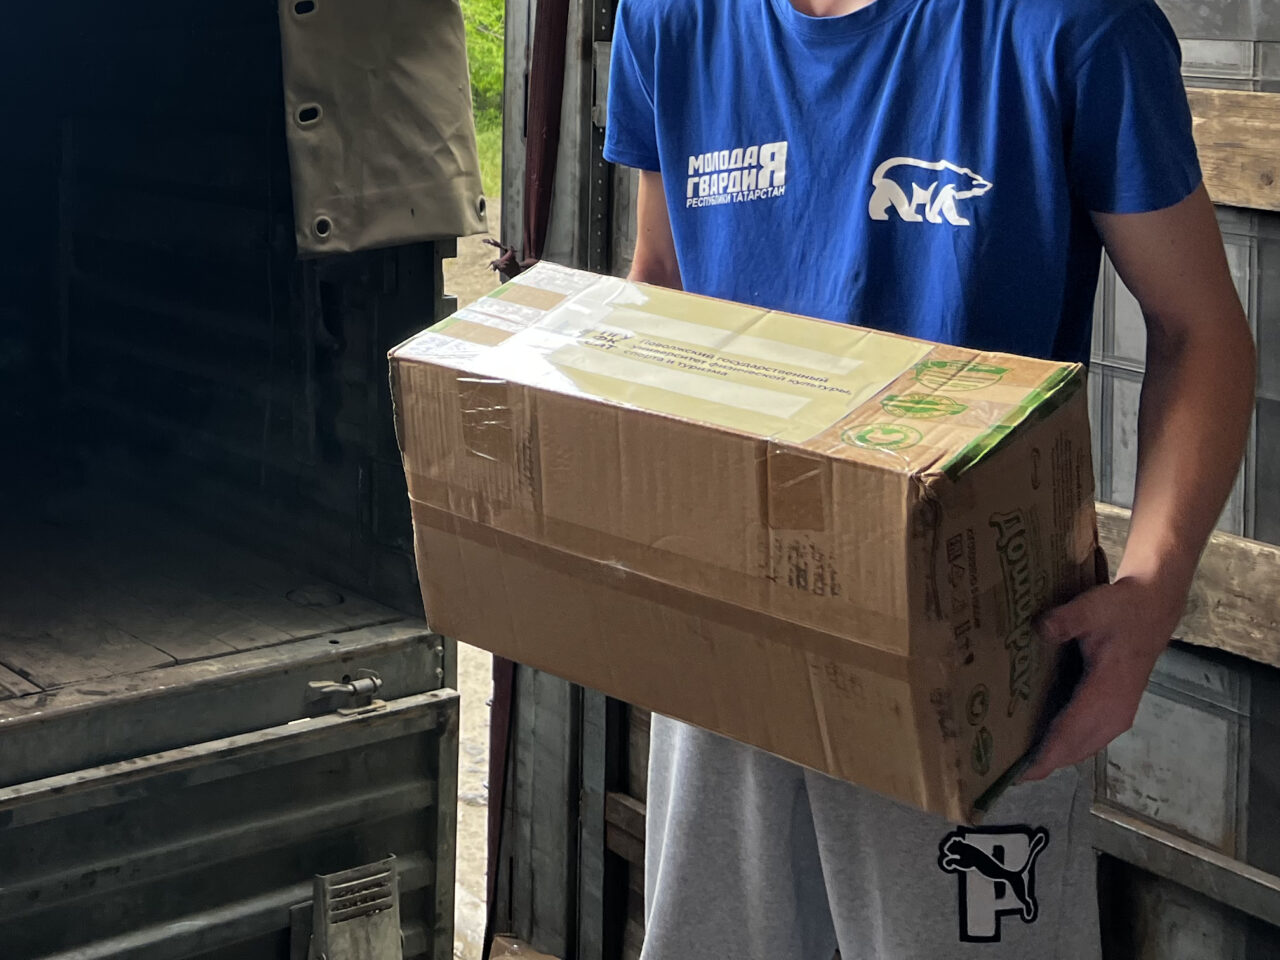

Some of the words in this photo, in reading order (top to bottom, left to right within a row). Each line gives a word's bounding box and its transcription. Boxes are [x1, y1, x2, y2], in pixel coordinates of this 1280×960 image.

[732, 185, 786, 203] ТАТАРСТАН
[624, 349, 664, 363] спорта
[677, 362, 728, 377] туризма
[632, 344, 706, 365] университет
[708, 361, 786, 382] физической
[639, 339, 715, 360] Поволжский
[717, 357, 829, 383] государственный
